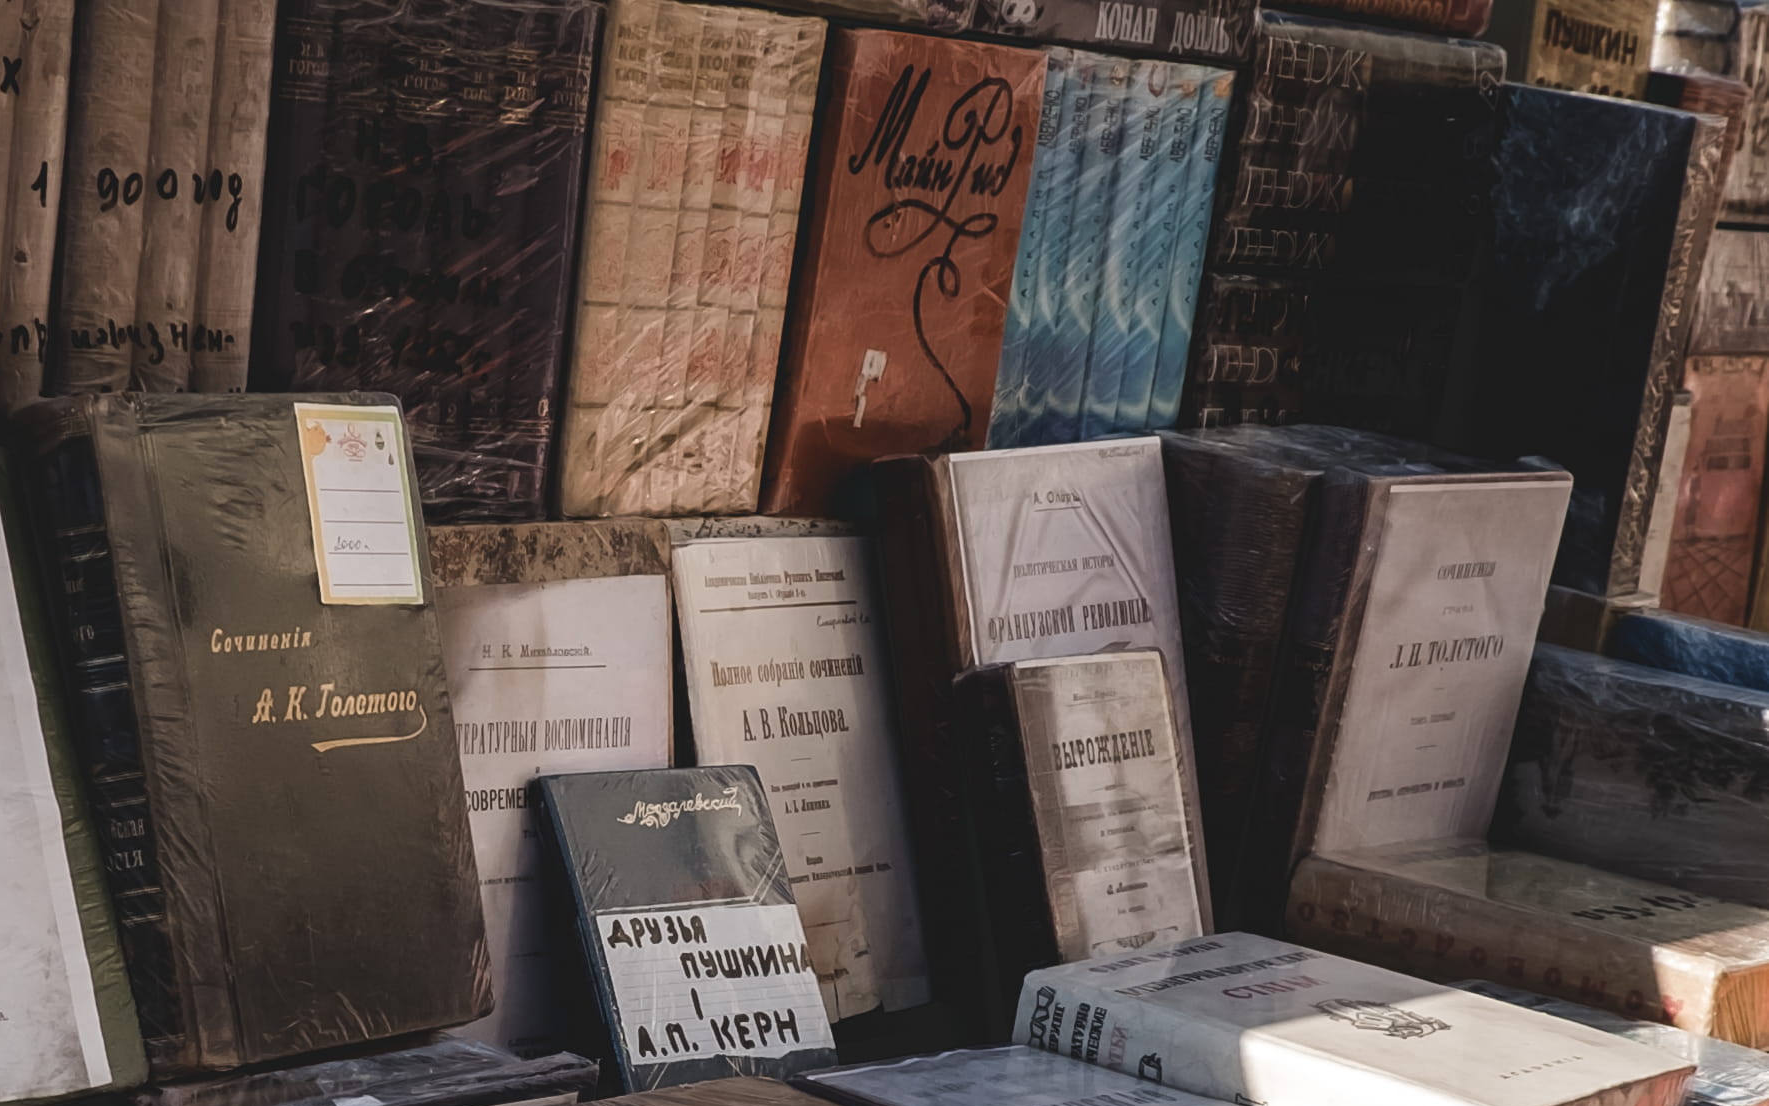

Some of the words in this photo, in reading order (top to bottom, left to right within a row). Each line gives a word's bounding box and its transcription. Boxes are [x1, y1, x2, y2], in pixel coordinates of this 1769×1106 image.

[1095, 1, 1157, 45] КОНАН
[1168, 11, 1230, 54] ДОЙЛЬ
[1544, 10, 1639, 66] ПУШКИН
[296, 164, 488, 240] ГОГОЛЬ
[988, 604, 1075, 643] ФРАНЦУЗСКОЙ
[607, 915, 708, 946] ДРУЗЬЯ
[680, 944, 815, 980] ПУШКИНА
[711, 1007, 801, 1049] КЕРН
